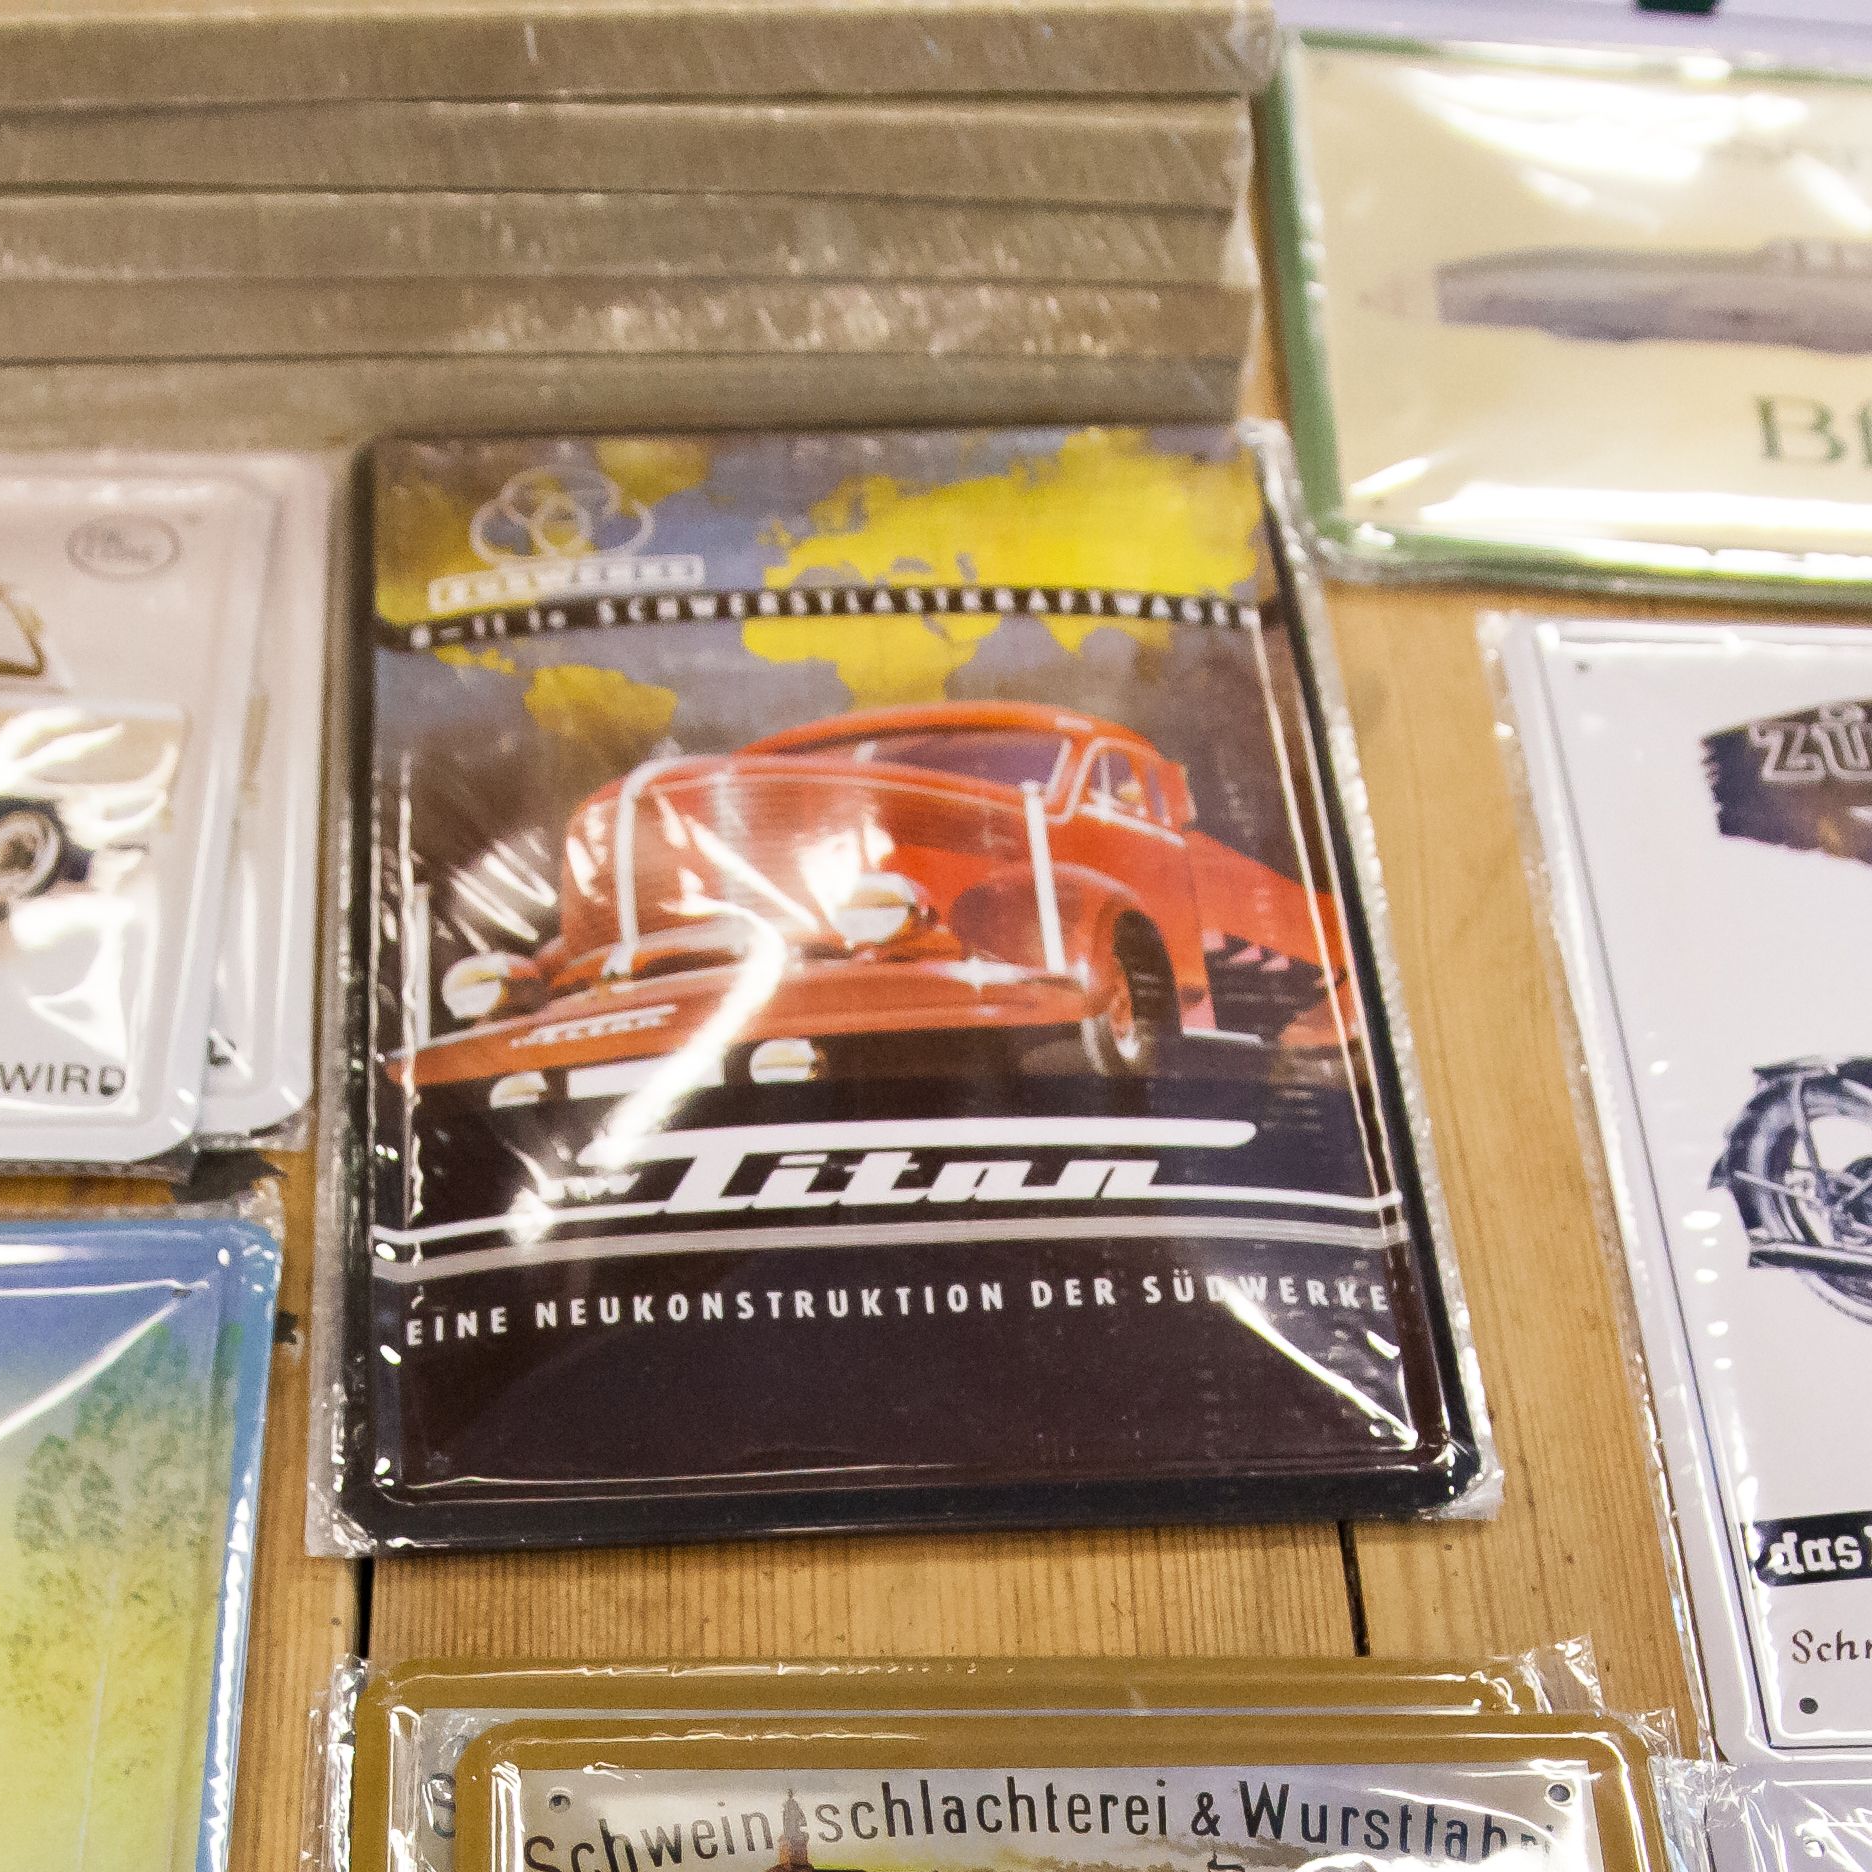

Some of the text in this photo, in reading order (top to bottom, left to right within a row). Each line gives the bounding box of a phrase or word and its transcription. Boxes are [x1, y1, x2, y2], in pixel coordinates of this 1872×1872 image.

[578, 1118, 1258, 1213] Titan
[405, 1303, 509, 1347] EINE
[535, 1280, 1006, 1328] NEUKONSTRUKTION
[1031, 1276, 1119, 1309] DER
[1768, 1530, 1863, 1576] das
[1191, 1790, 1222, 1838] &
